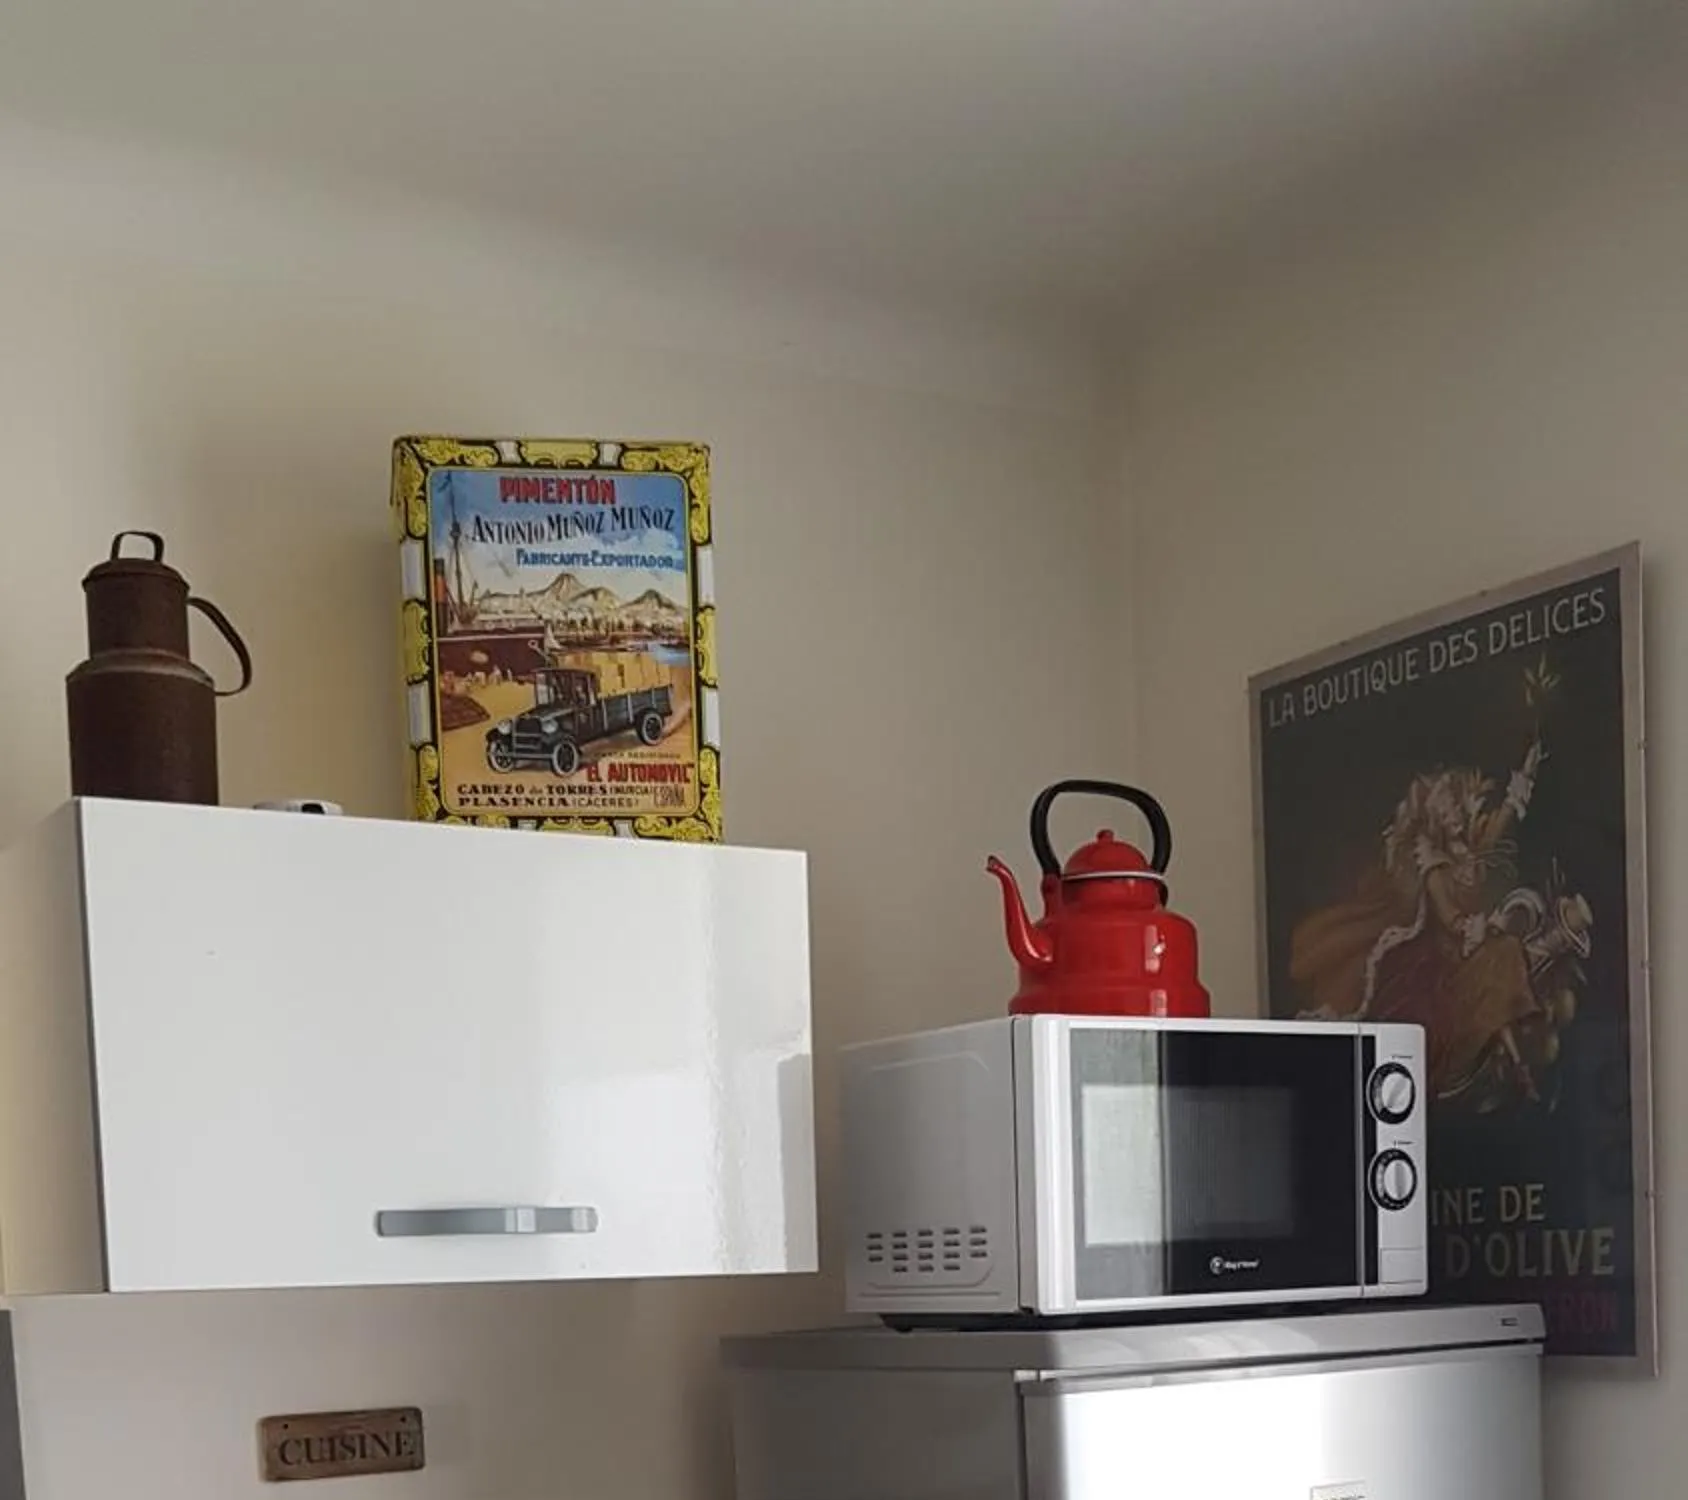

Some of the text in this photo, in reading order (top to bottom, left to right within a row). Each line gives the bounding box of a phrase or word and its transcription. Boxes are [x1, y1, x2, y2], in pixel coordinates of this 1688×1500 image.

[499, 475, 617, 505] PIMENTÓN
[471, 504, 676, 545] ANTONIO MUÑOZ MUÑOZ
[1269, 588, 1606, 728] LA BOUTIQUE DES DELICES
[457, 784, 525, 795] CABEZO
[458, 797, 569, 807] PLASENCIA
[1500, 1184, 1545, 1223] DE
[1445, 1227, 1616, 1279] D'OLIVE
[277, 1431, 415, 1466] CUISINE
